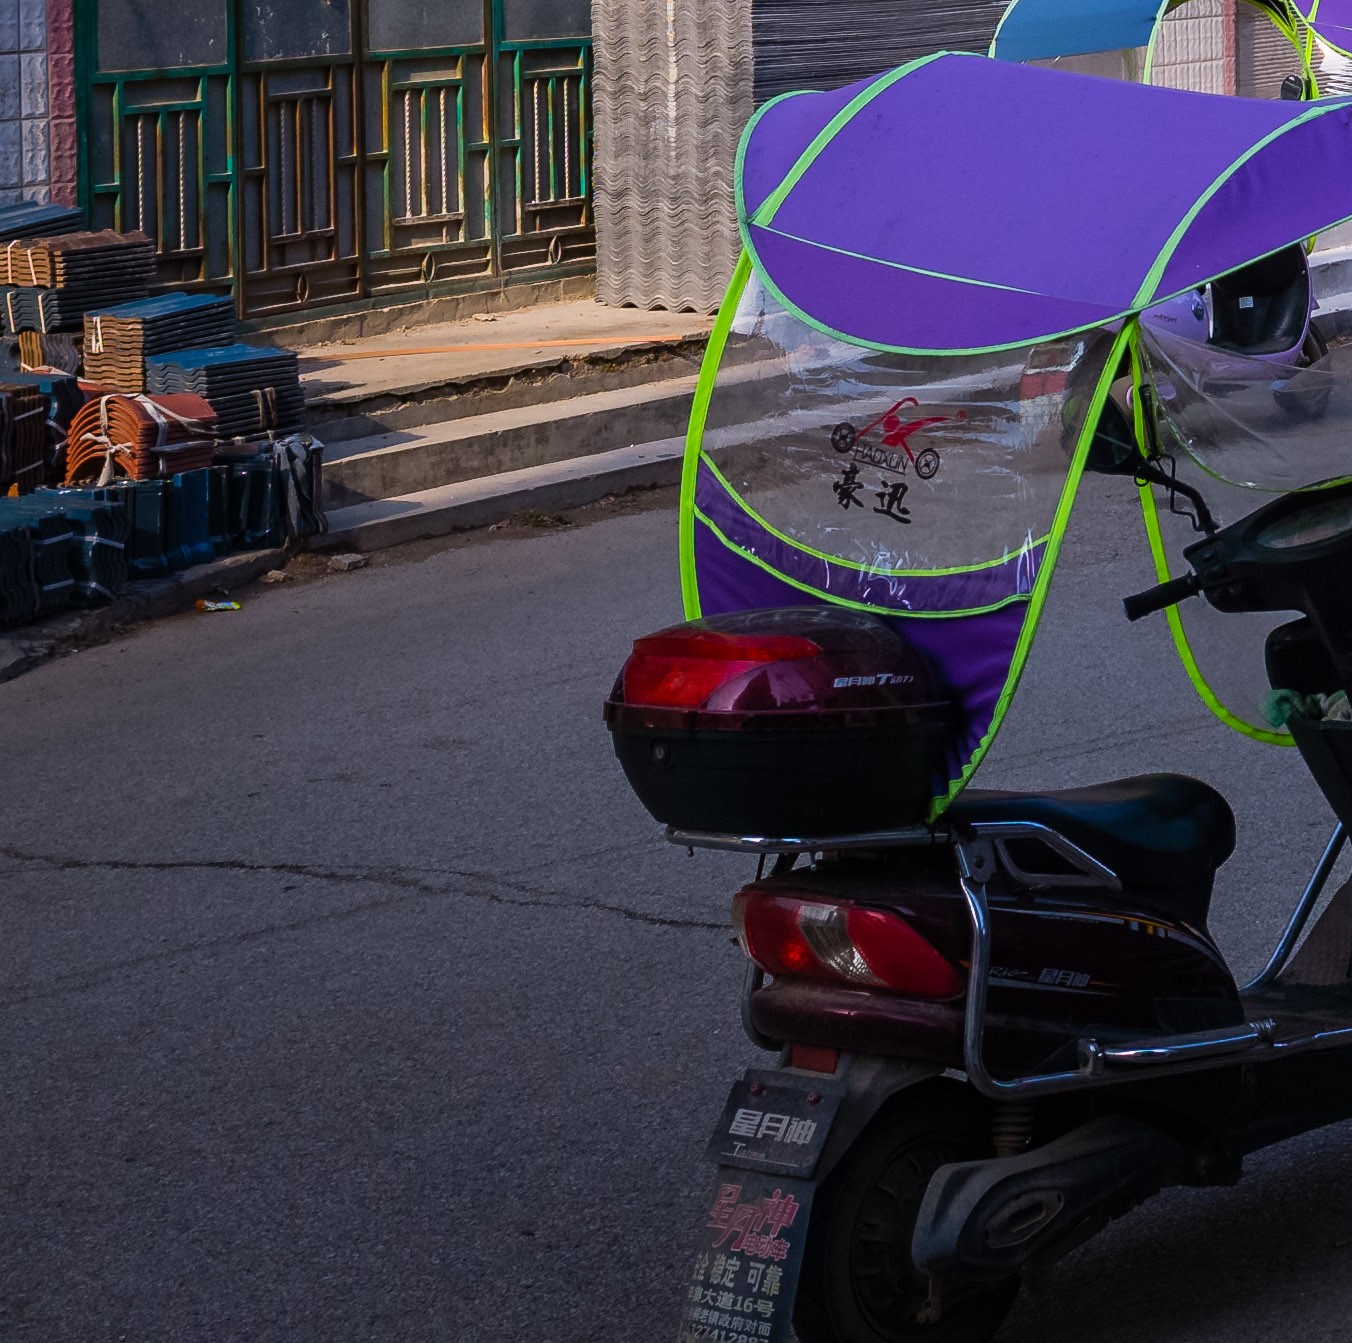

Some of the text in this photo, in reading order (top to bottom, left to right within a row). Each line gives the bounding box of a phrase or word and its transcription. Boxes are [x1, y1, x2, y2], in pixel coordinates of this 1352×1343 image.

[853, 442, 909, 473] HAOXUN
[831, 462, 912, 525] 豪迅
[728, 1108, 818, 1145] 星月神
